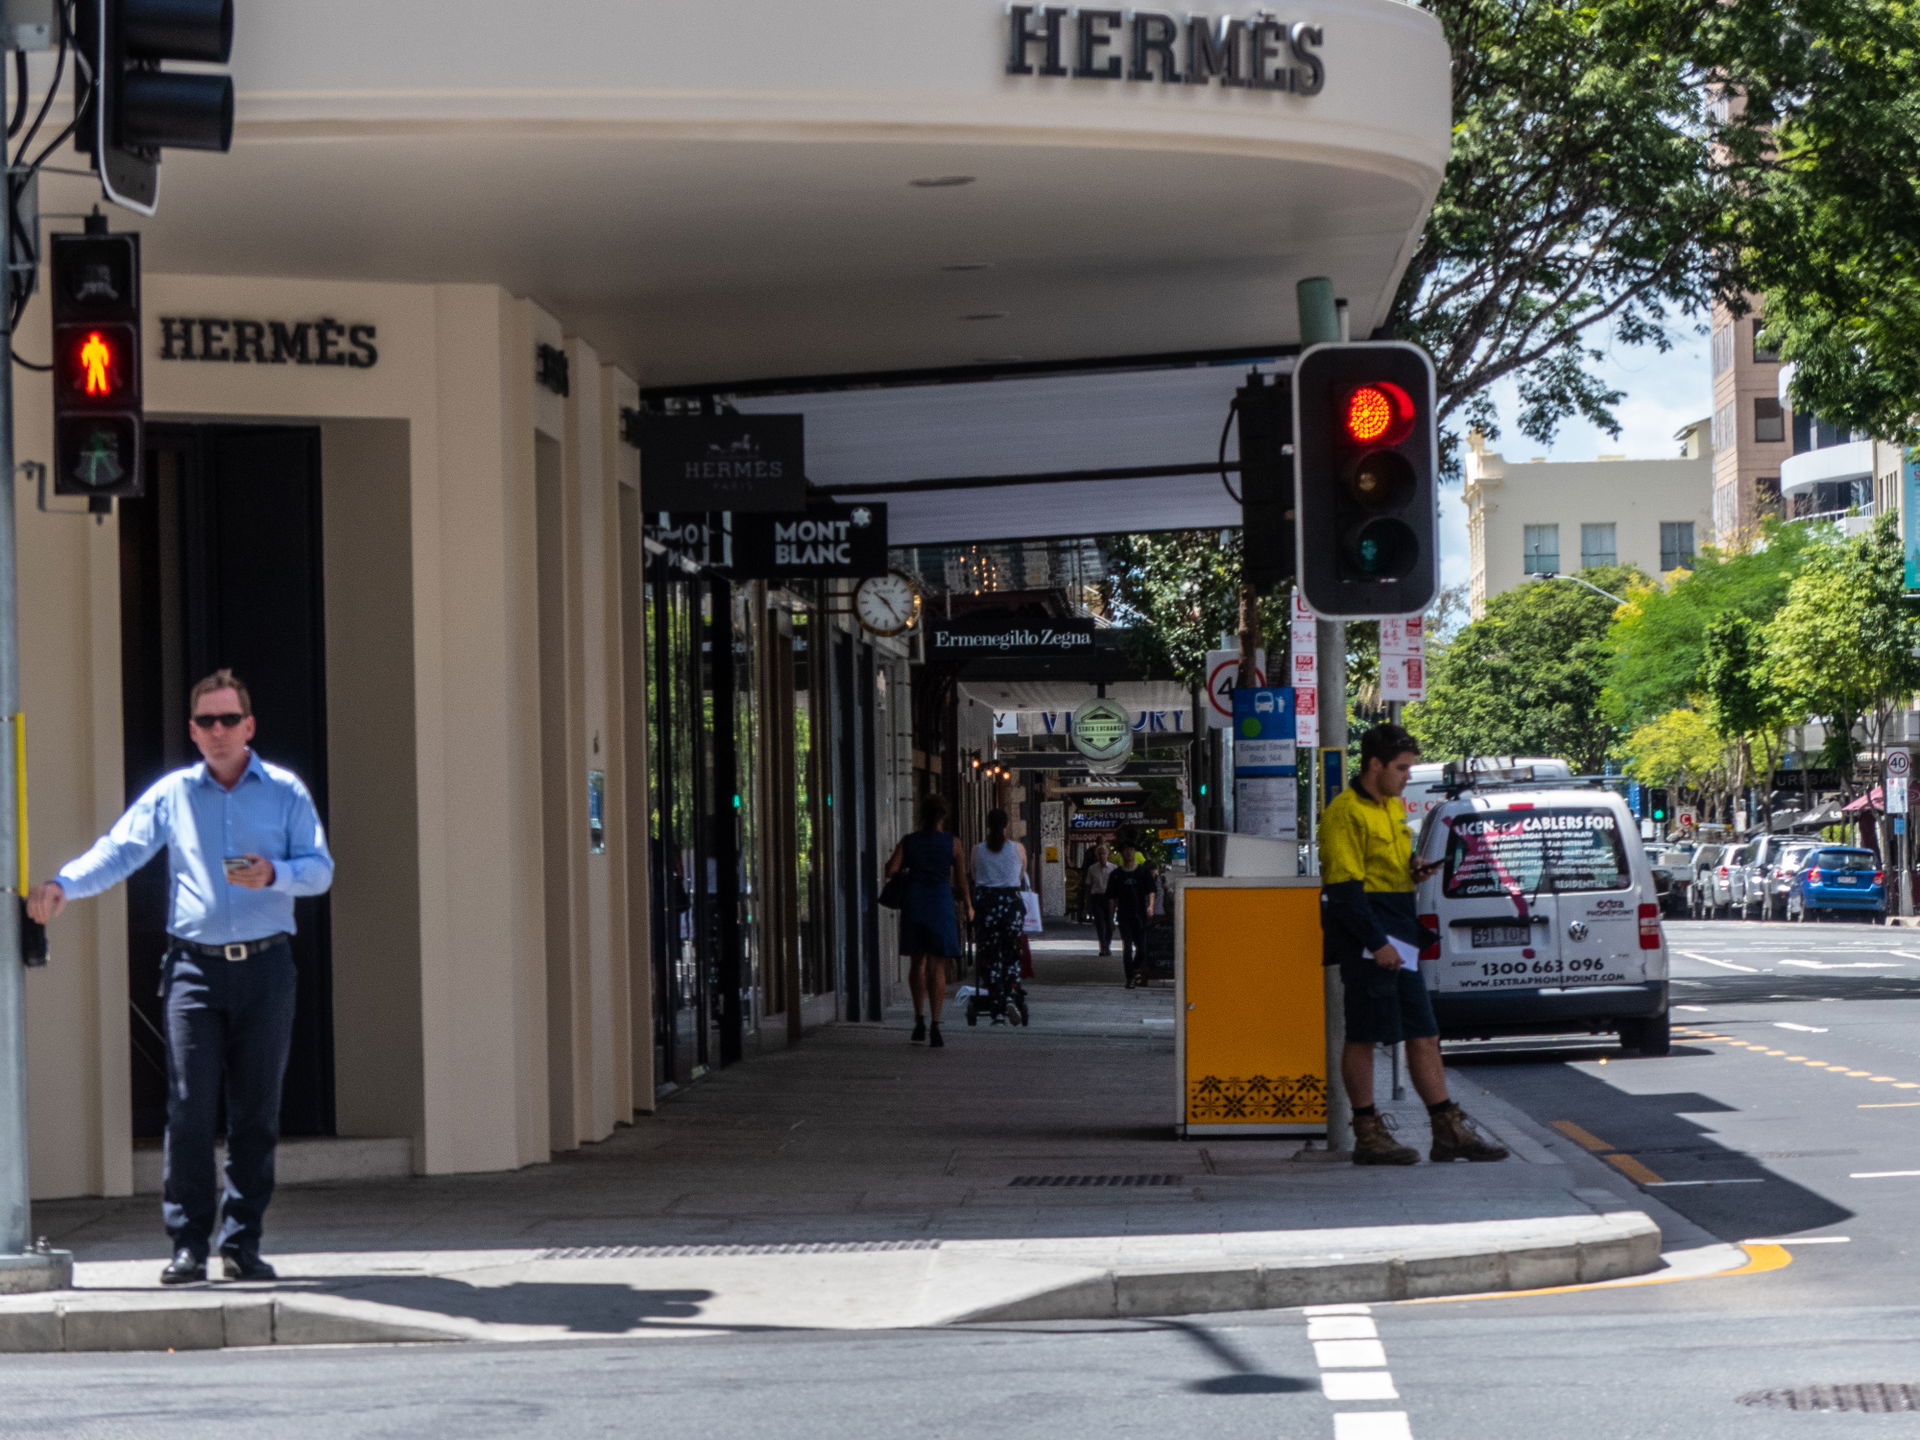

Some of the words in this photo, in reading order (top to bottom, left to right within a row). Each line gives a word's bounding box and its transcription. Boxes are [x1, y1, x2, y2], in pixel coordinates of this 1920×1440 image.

[160, 317, 378, 368] HERMÈS
[775, 520, 850, 542] MONT
[775, 543, 851, 564] BLANC
[935, 629, 1039, 650] Ermenegildo
[1040, 629, 1092, 648] Zegna
[1217, 677, 1233, 701] 4
[1042, 711, 1184, 733] VIRY
[1891, 757, 1906, 768] 40
[1074, 820, 1117, 829] CHEMIST
[1455, 819, 1521, 835] LICEN
[1522, 816, 1584, 831] CABLERS
[1584, 816, 1614, 830] FOR
[1467, 880, 1524, 893] COMMEIAL
[1481, 962, 1527, 976] 1300
[1532, 960, 1564, 974] 663
[1569, 958, 1604, 972] 096
[1460, 974, 1625, 988] WWW.EXTRAPHONEPOINT.COM
